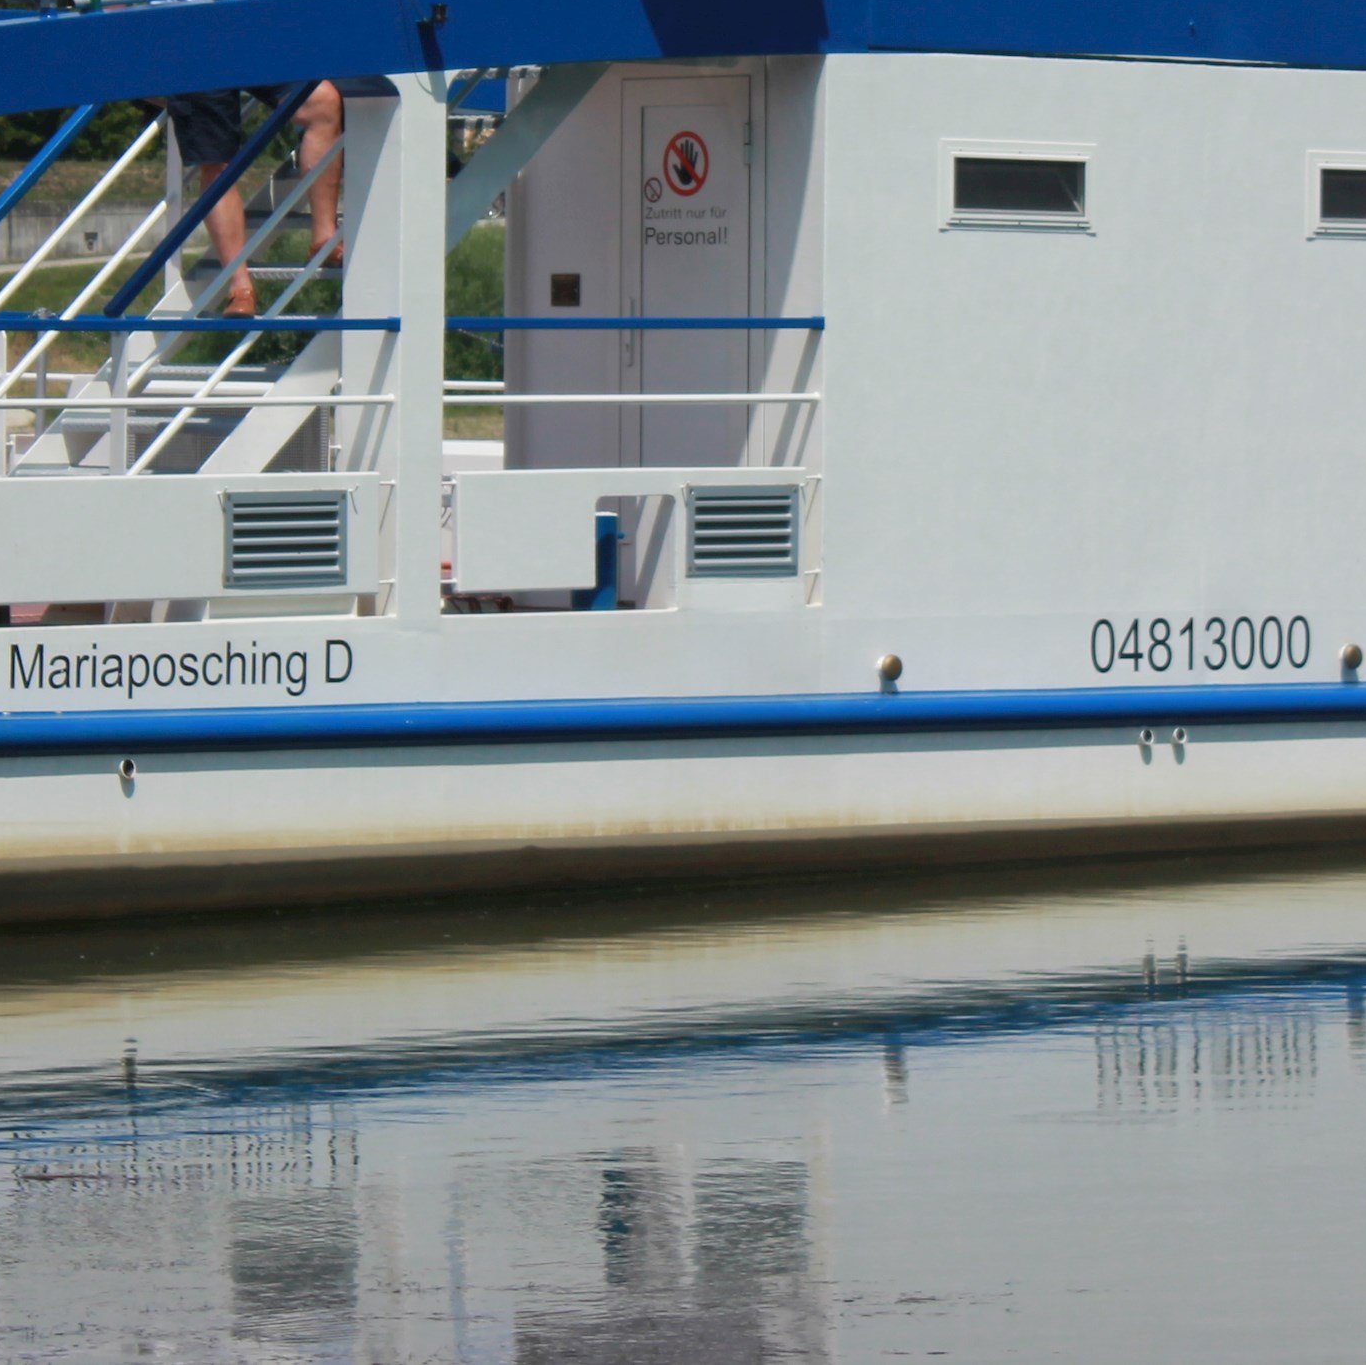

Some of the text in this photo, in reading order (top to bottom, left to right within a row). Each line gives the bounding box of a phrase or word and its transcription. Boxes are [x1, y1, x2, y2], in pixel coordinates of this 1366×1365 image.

[644, 205, 728, 220] Zutritt nur für
[644, 225, 728, 245] Personal!
[1090, 615, 1311, 673] 04813000
[9, 639, 354, 699] Mariaposching D
